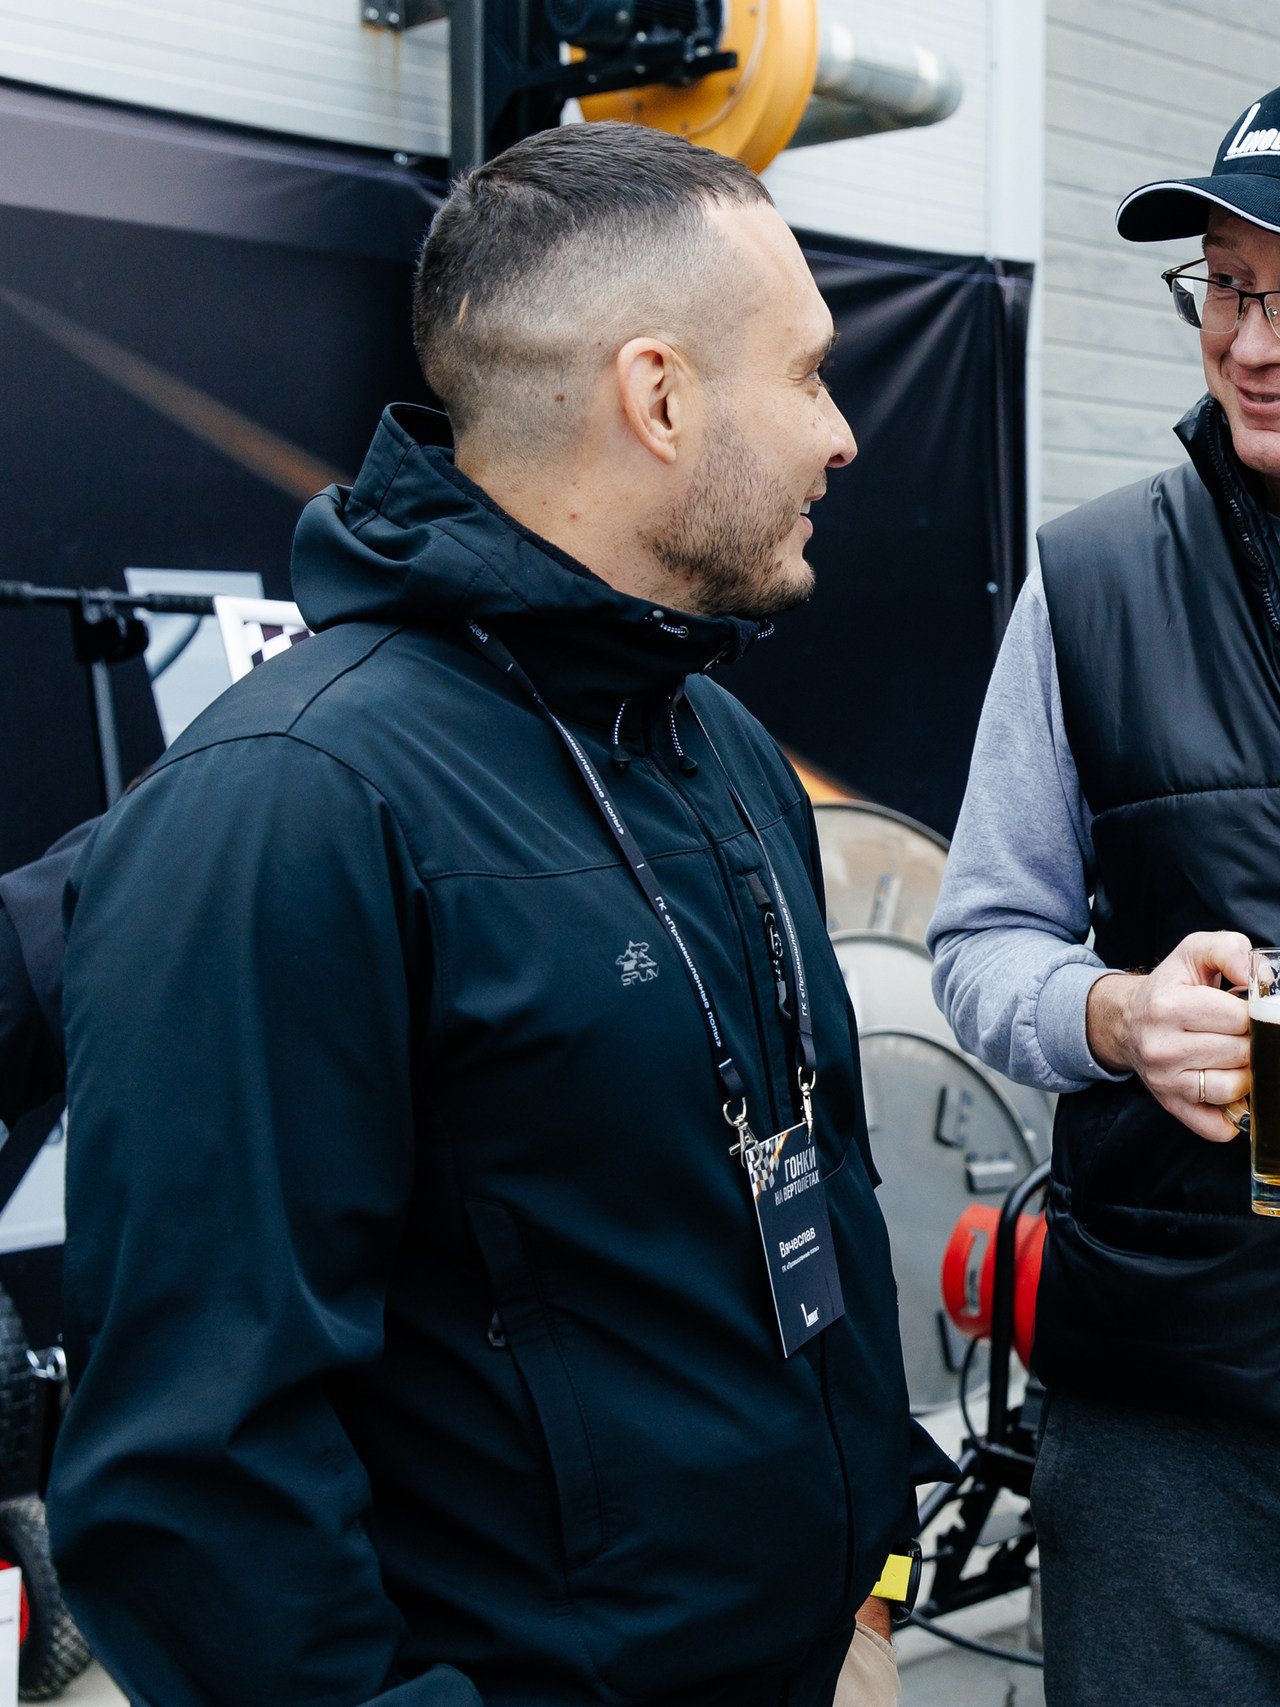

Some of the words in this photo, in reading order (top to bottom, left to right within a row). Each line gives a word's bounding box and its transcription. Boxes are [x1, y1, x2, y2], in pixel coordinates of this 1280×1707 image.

[655, 896, 668, 911] ГК
[664, 914, 710, 1009] «Промышленные
[707, 1011, 722, 1048] полы»
[801, 1002, 808, 1016] ГК
[784, 1146, 817, 1183] ГОНКИ
[774, 1189, 784, 1206] НА
[779, 1227, 816, 1258] Вячеслав
